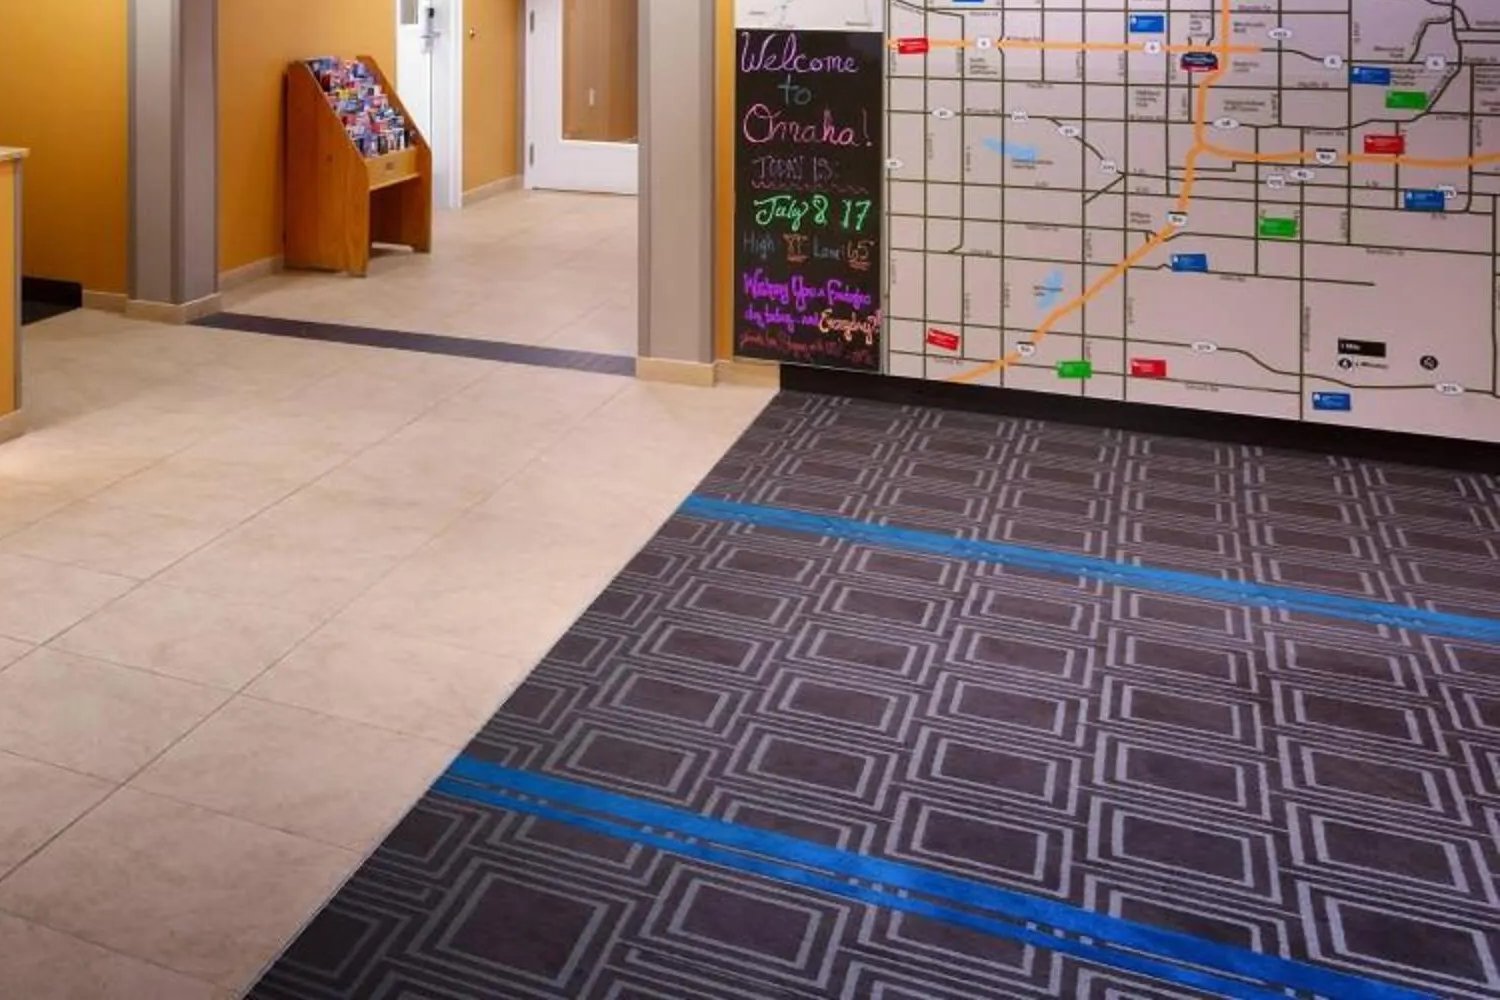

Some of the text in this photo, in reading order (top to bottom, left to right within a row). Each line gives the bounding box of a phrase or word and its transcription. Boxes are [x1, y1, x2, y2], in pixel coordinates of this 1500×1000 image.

[741, 32, 859, 73] Welcome
[777, 73, 813, 105] to
[743, 103, 873, 147] Omaha!
[753, 193, 873, 232] July 8 17
